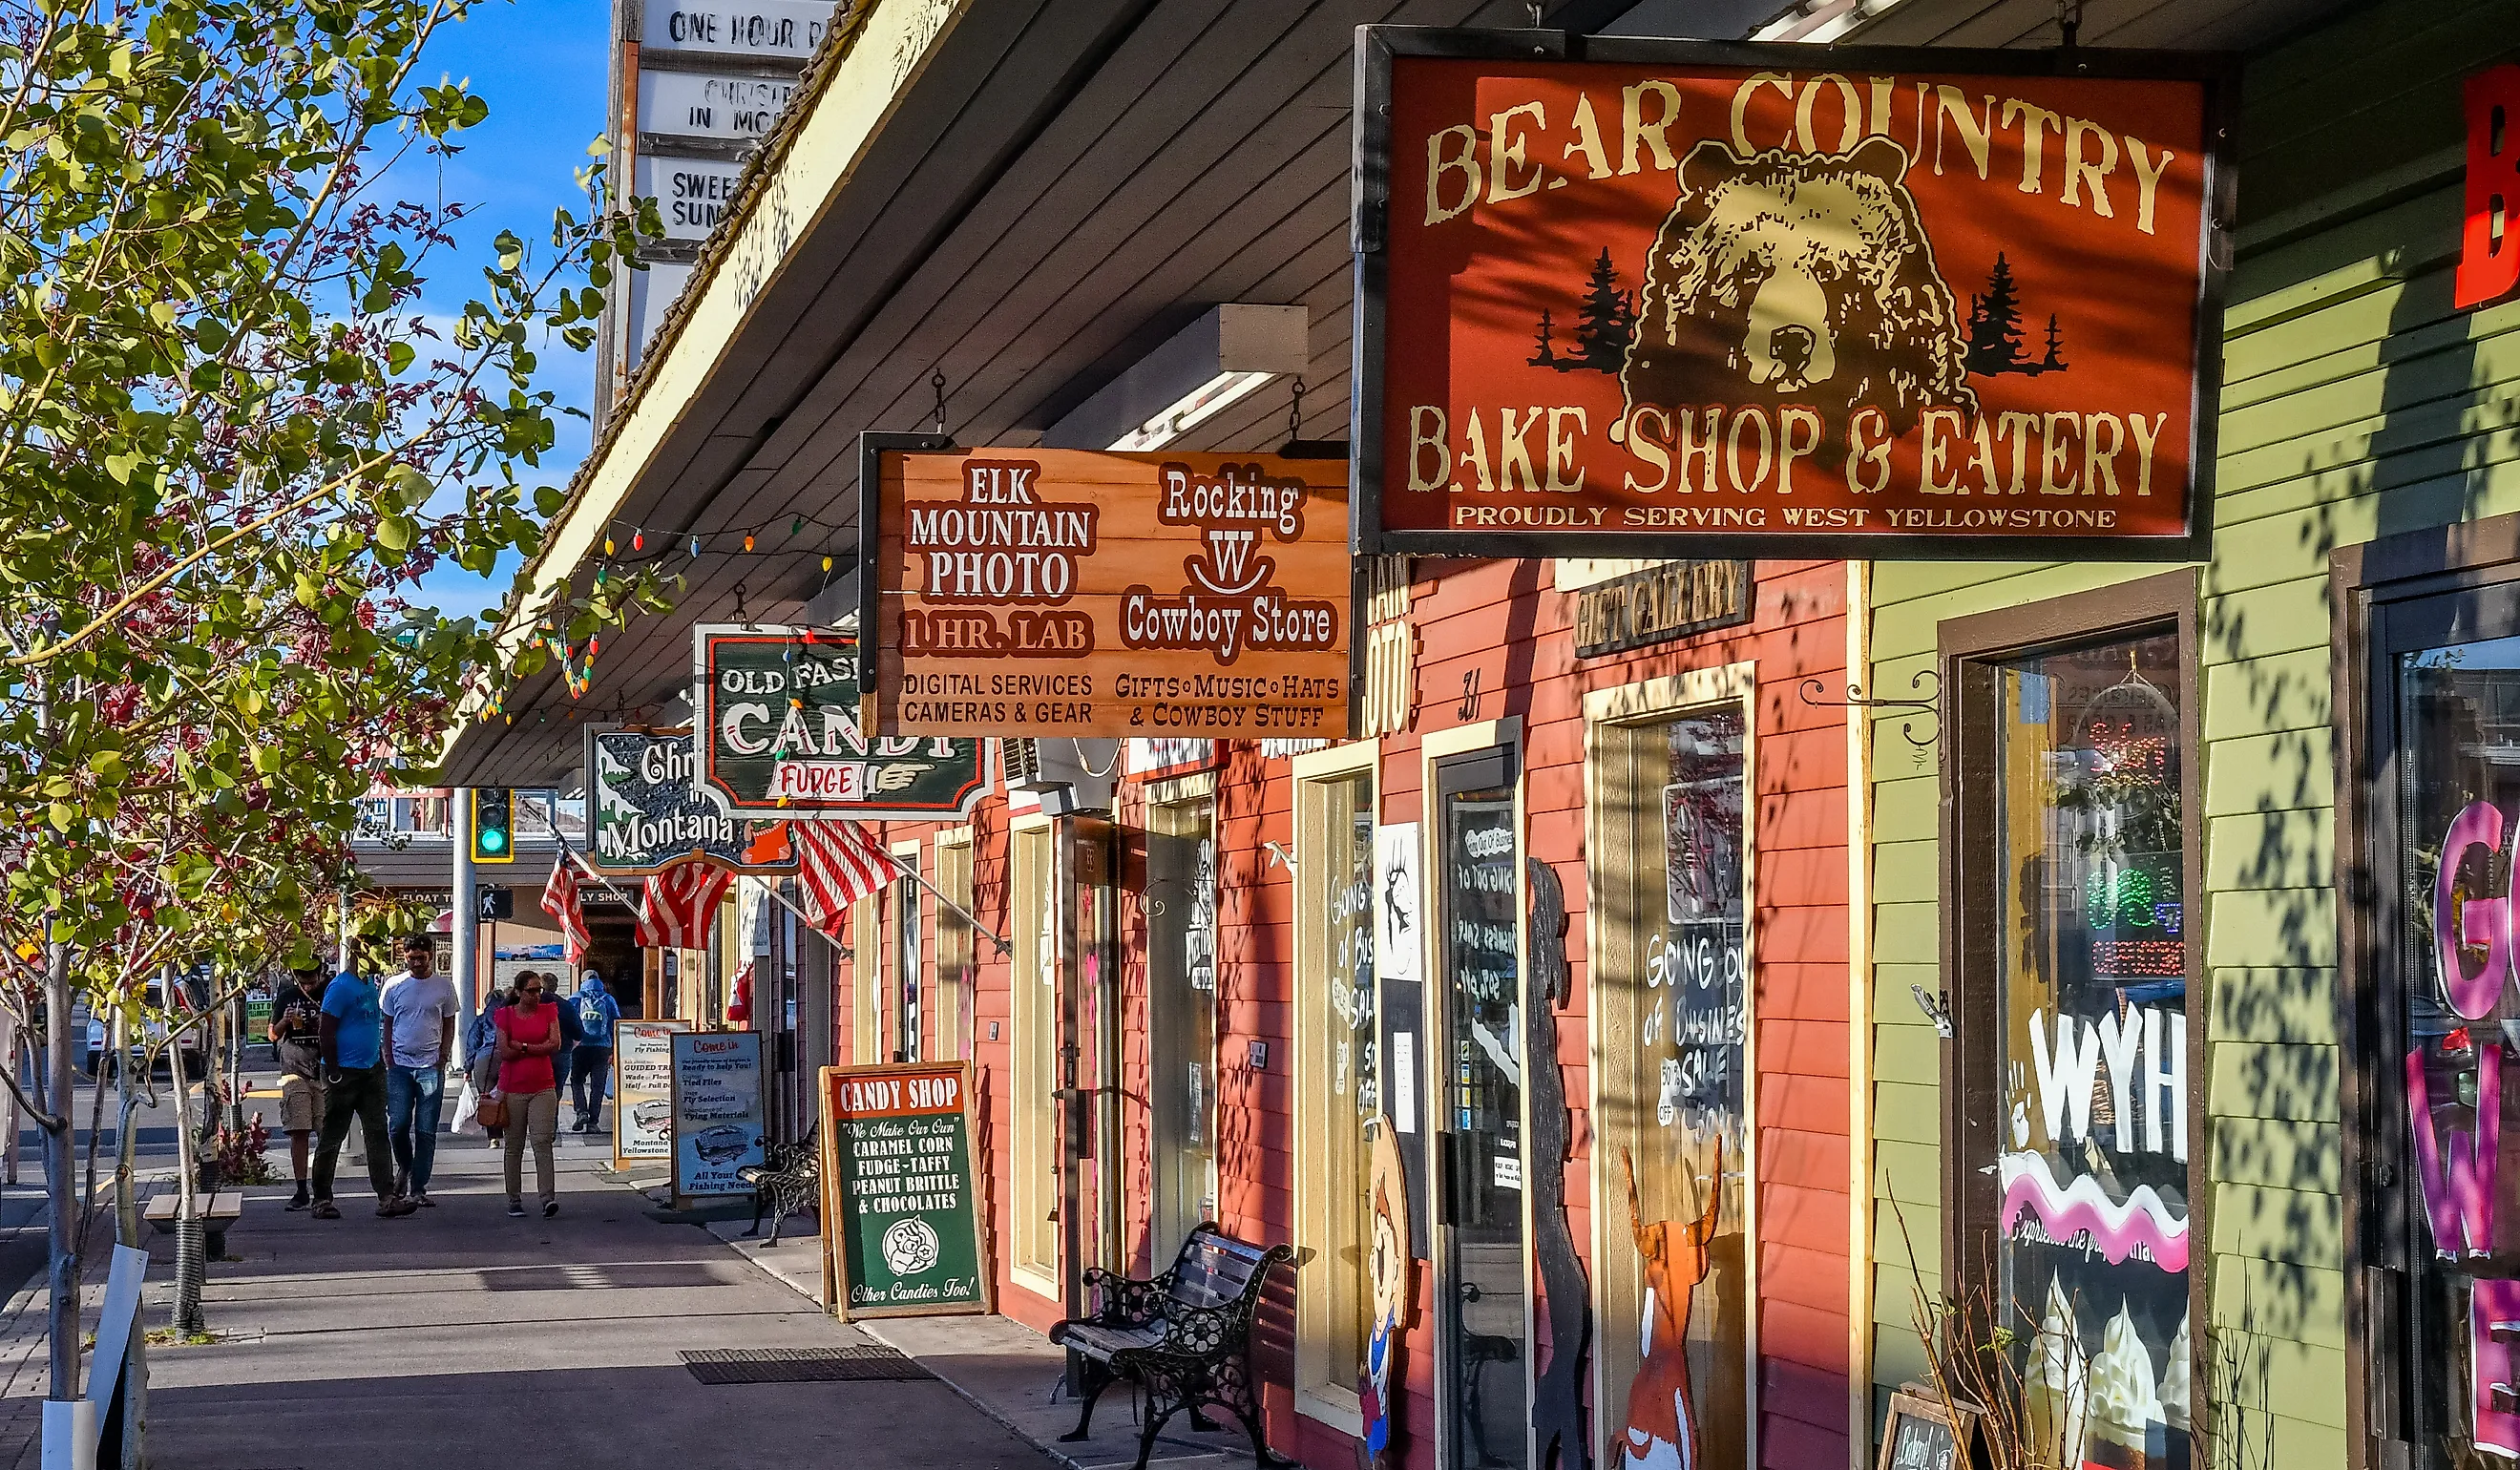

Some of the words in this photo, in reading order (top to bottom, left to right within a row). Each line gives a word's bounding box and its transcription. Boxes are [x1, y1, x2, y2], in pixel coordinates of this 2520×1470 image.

[669, 10, 718, 43] ONE
[730, 14, 793, 48] HOUR
[688, 107, 711, 128] IN
[1424, 78, 1682, 226] BEAR
[1731, 74, 2175, 235] COUNTRY
[672, 173, 742, 200] SWEE
[1409, 405, 1587, 494] BAKE
[1623, 405, 1819, 496] SHOP
[1846, 410, 1891, 495] &
[1920, 410, 2167, 500] EATERY
[970, 467, 1033, 505] ELK
[1165, 471, 1299, 535] Rocking
[910, 509, 1090, 548] MOUNTAIN
[1457, 506, 1608, 528] PROUDLY
[1623, 506, 1766, 528] SERVING
[1782, 506, 1869, 527] WEST
[1887, 506, 2118, 529] YELLOWSTONE
[1209, 530, 1253, 582] W
[929, 552, 1070, 598] PHOTO
[1574, 585, 1627, 648] GIFT
[1631, 559, 1738, 638] GALLERY
[907, 620, 919, 649] 1
[936, 620, 1002, 649] HR.
[1018, 620, 1086, 650] LAB
[1126, 596, 1242, 658] Cowboy
[1251, 596, 1330, 642] Store
[722, 669, 786, 694] OLD
[906, 674, 984, 696] DIGITAL
[991, 673, 1093, 696] SERVICES
[1116, 675, 1179, 699] GIFTS
[1194, 674, 1270, 699] MUSIC
[1282, 676, 1339, 699] HATS
[904, 702, 1006, 724] CAMERAS
[1014, 703, 1027, 724] &
[1034, 702, 1093, 724] GEAR
[1130, 708, 1144, 727] &
[1152, 704, 1247, 727] COWBOY
[1255, 705, 1324, 728] STUFF
[780, 765, 853, 797] FUDGE
[606, 806, 733, 859] Montana
[402, 893, 438, 904] FLOAT
[443, 893, 453, 903] T
[598, 892, 628, 902] SHOP
[1331, 874, 1367, 924] GOING
[1646, 934, 1714, 990] GOING
[694, 1040, 725, 1053] Come
[728, 1038, 740, 1049] in
[1681, 1047, 1727, 1097] SALE
[625, 1082, 641, 1090] Half
[841, 1080, 901, 1112] CANDY
[909, 1077, 957, 1108] SHOP
[683, 1096, 697, 1104] Fly
[870, 1122, 905, 1137] Make
[908, 1119, 929, 1136] Our
[853, 1138, 914, 1157] CARAMEL
[918, 1136, 954, 1152] CORN
[689, 1182, 725, 1191] Fishing
[694, 1171, 709, 1181] All
[711, 1171, 735, 1180] Your
[851, 1177, 901, 1196] PEANUT
[906, 1173, 960, 1192] BRITTLE
[859, 1200, 869, 1214] &
[873, 1193, 956, 1213] CHOCOLATES
[850, 1285, 887, 1303] Other
[891, 1281, 938, 1301] Candies
[943, 1276, 975, 1297] Too!
